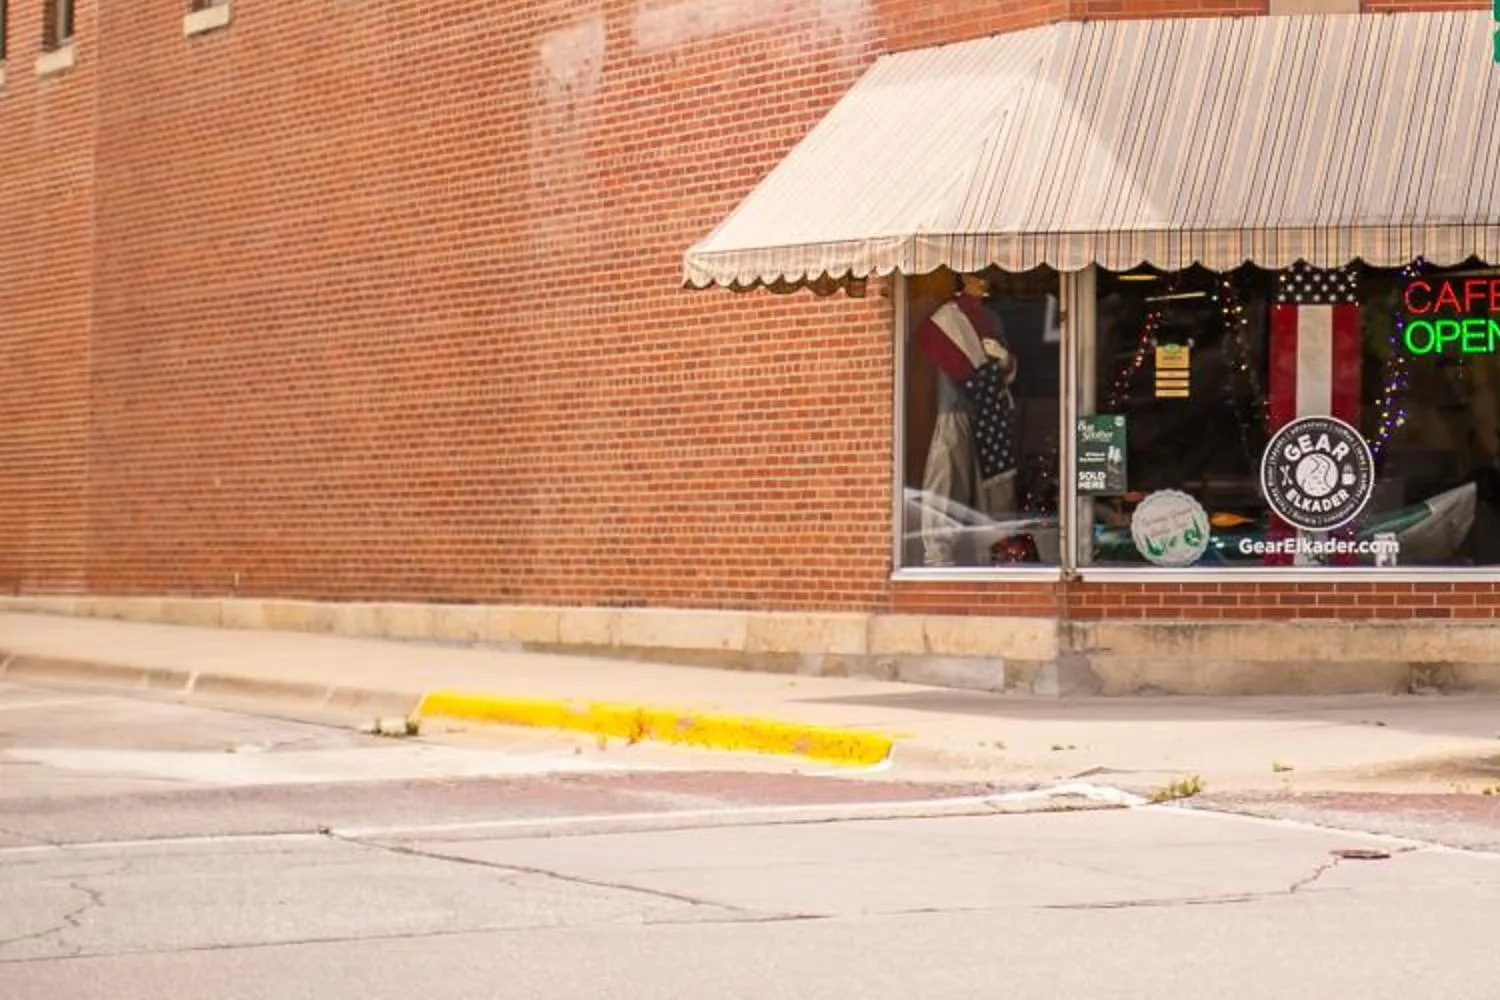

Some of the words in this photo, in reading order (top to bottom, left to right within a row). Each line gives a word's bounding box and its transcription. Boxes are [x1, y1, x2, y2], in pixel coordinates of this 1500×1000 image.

[1284, 433, 1350, 461] GEAR
[1078, 471, 1107, 481] SOLD
[1285, 488, 1350, 513] ELKADER
[1238, 537, 1400, 554] GearElkader.com
